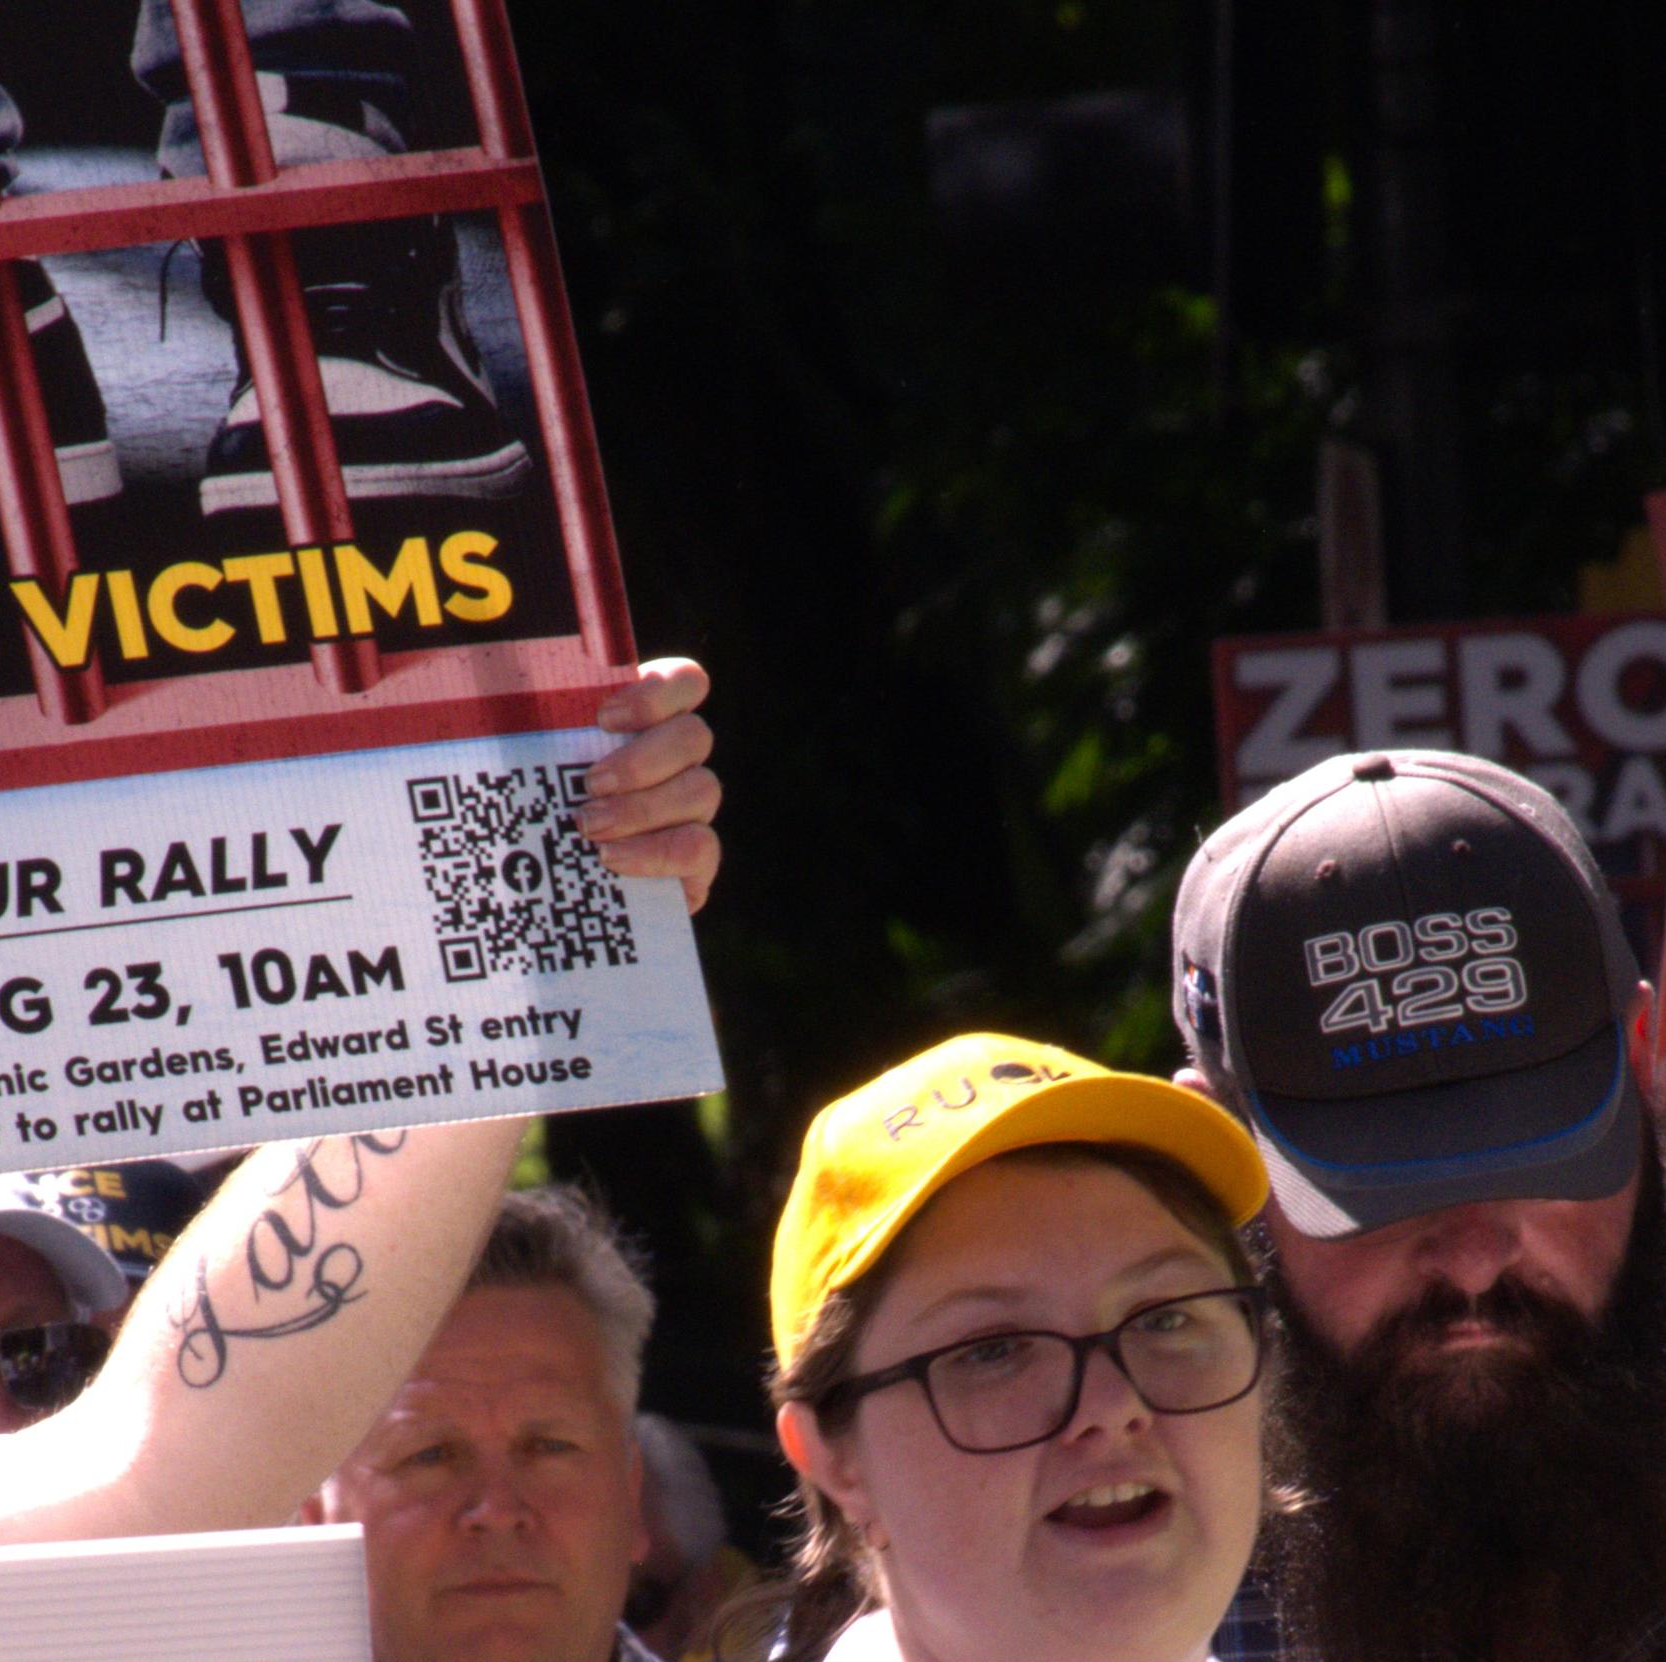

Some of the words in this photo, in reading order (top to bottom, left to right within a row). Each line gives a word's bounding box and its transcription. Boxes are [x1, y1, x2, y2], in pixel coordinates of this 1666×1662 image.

[10, 531, 513, 669] VICTIMS
[99, 823, 343, 908] RALLY
[84, 961, 192, 1026] 23,
[218, 945, 405, 1011] 10AM
[1303, 906, 1518, 987] BOSS
[1319, 956, 1528, 1034] 429
[64, 1040, 246, 1088] Gardens,
[260, 1017, 410, 1067] Edward
[424, 1007, 465, 1047] St
[480, 1004, 583, 1042] entry
[1331, 1013, 1535, 1070] MUSTANG
[15, 1109, 59, 1143] to
[74, 1095, 165, 1136] rally
[182, 1089, 223, 1123] at
[238, 1060, 465, 1118] Parliament
[471, 1053, 593, 1090] House
